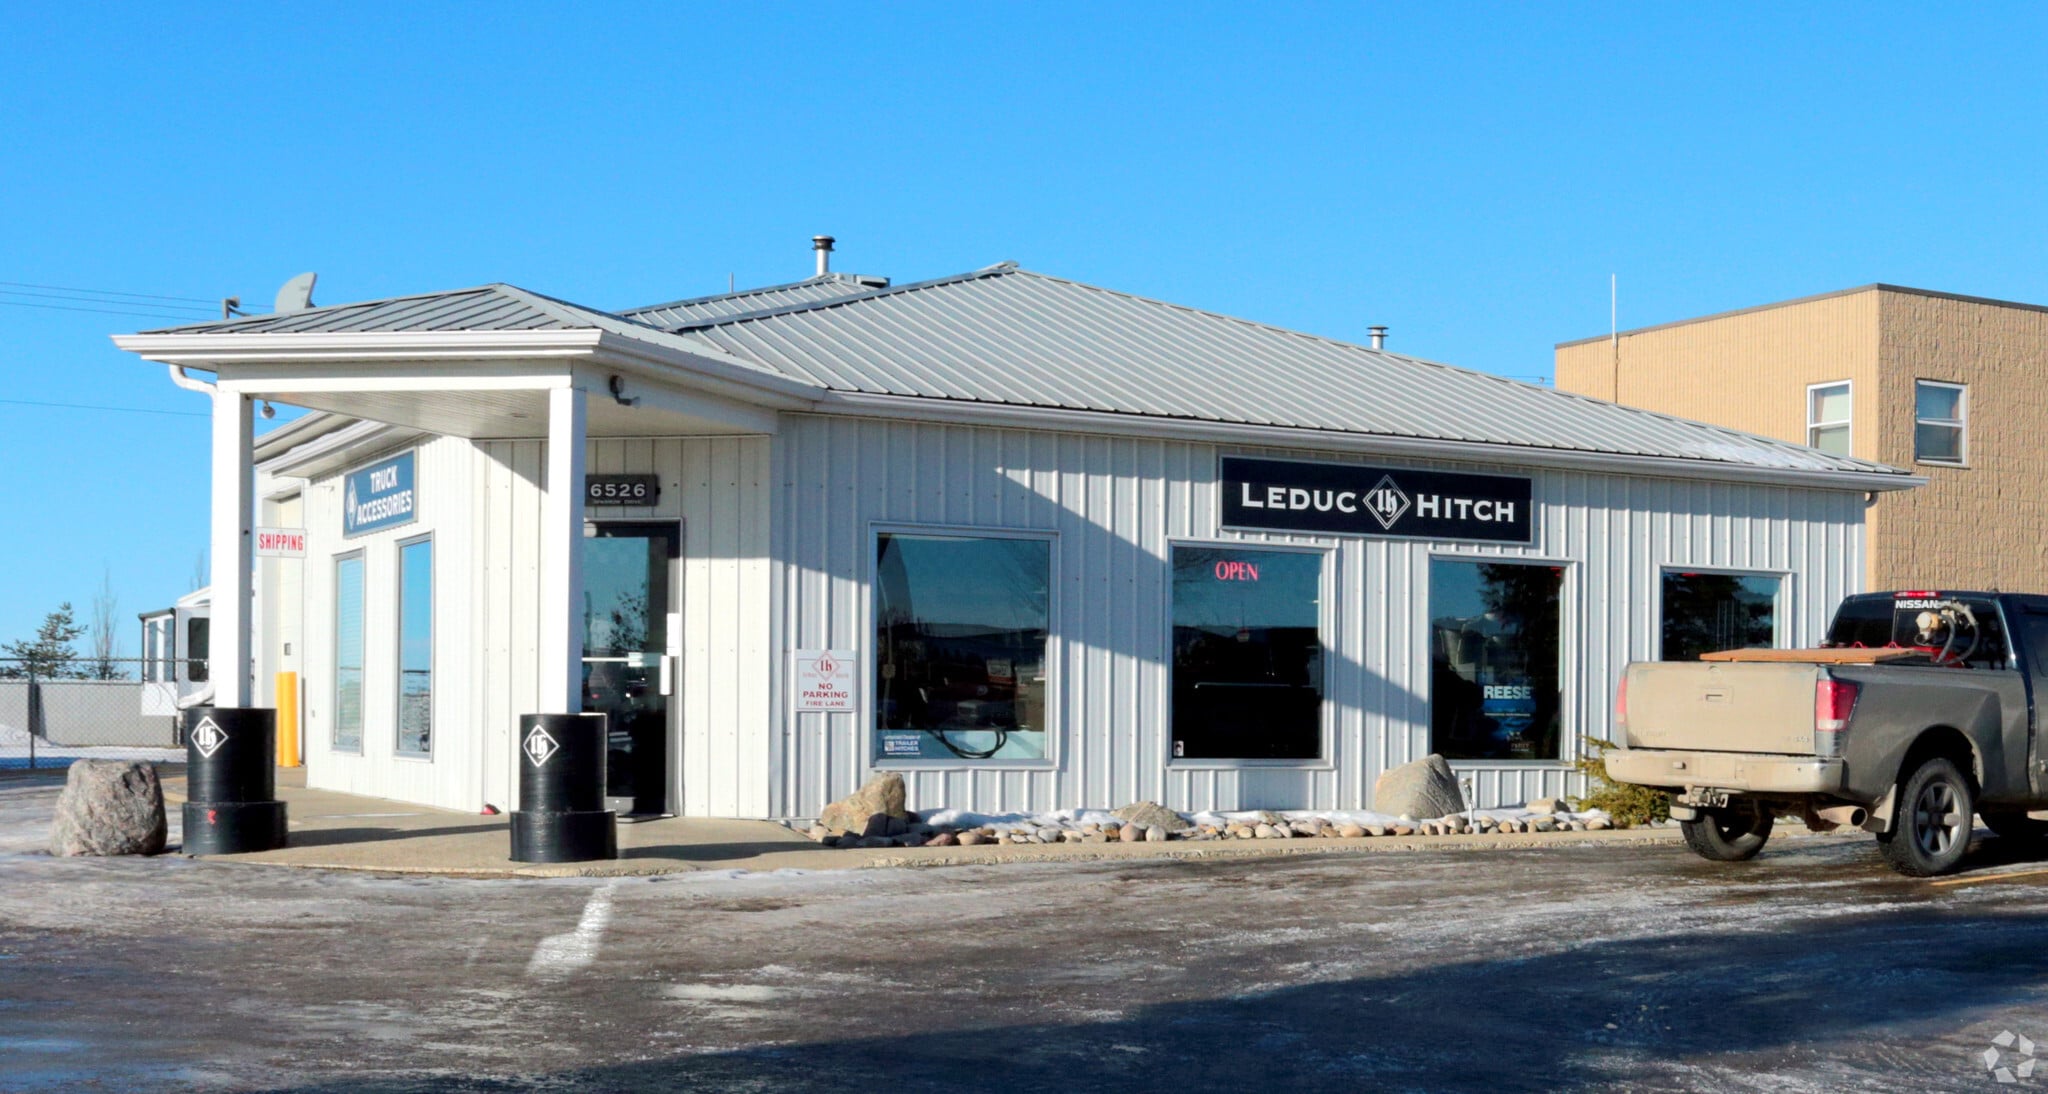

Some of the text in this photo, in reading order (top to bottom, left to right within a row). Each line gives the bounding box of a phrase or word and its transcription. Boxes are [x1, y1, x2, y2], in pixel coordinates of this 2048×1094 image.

[370, 465, 397, 494] TRUCK
[590, 484, 646, 497] 6526
[357, 490, 412, 525] ACCESSORIES
[1242, 483, 1357, 512] LEDUC
[1417, 494, 1514, 522] HITCH
[259, 533, 304, 551] SHIPPING
[1215, 560, 1259, 581] OPEN
[1896, 600, 1938, 609] NISSAN
[1484, 685, 1531, 700] REESE
